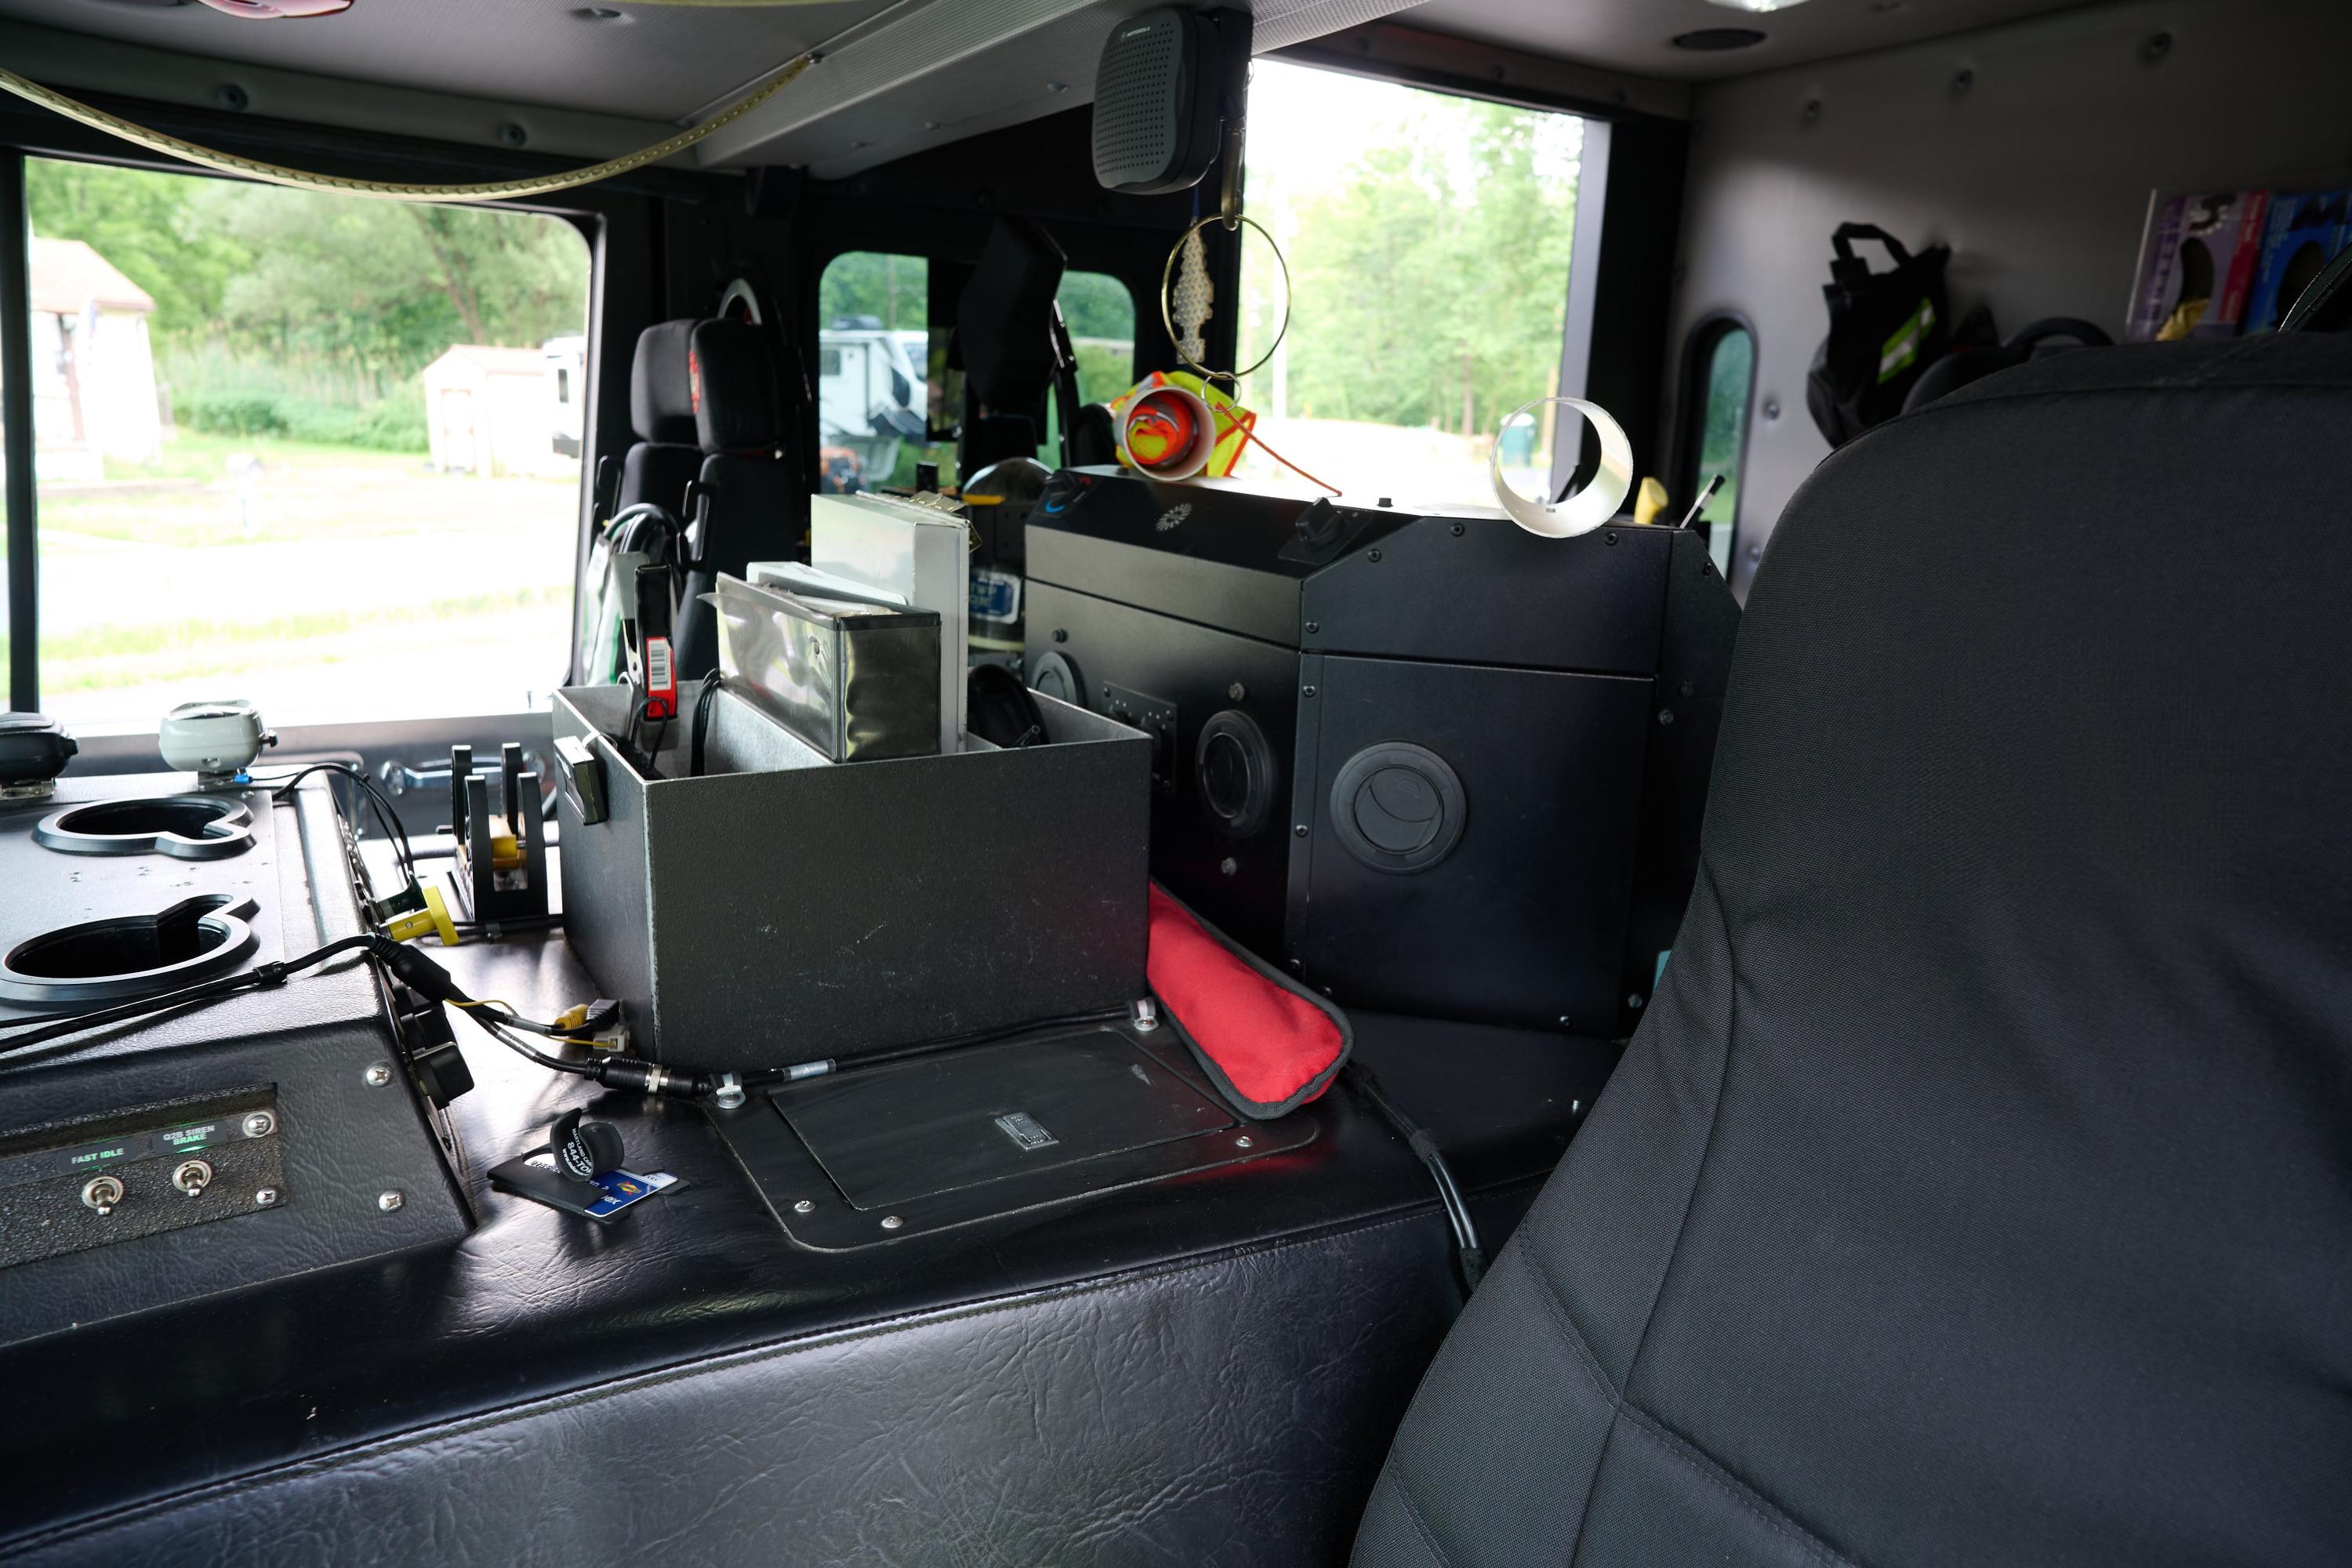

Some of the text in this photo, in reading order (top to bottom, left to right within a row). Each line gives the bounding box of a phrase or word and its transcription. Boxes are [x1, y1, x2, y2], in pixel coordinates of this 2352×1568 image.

[163, 1125, 216, 1141] Q2B SIREN
[172, 1133, 207, 1145] BRAKE
[572, 1128, 586, 1157] MARYLAND
[71, 1148, 125, 1164] FAST IDLE
